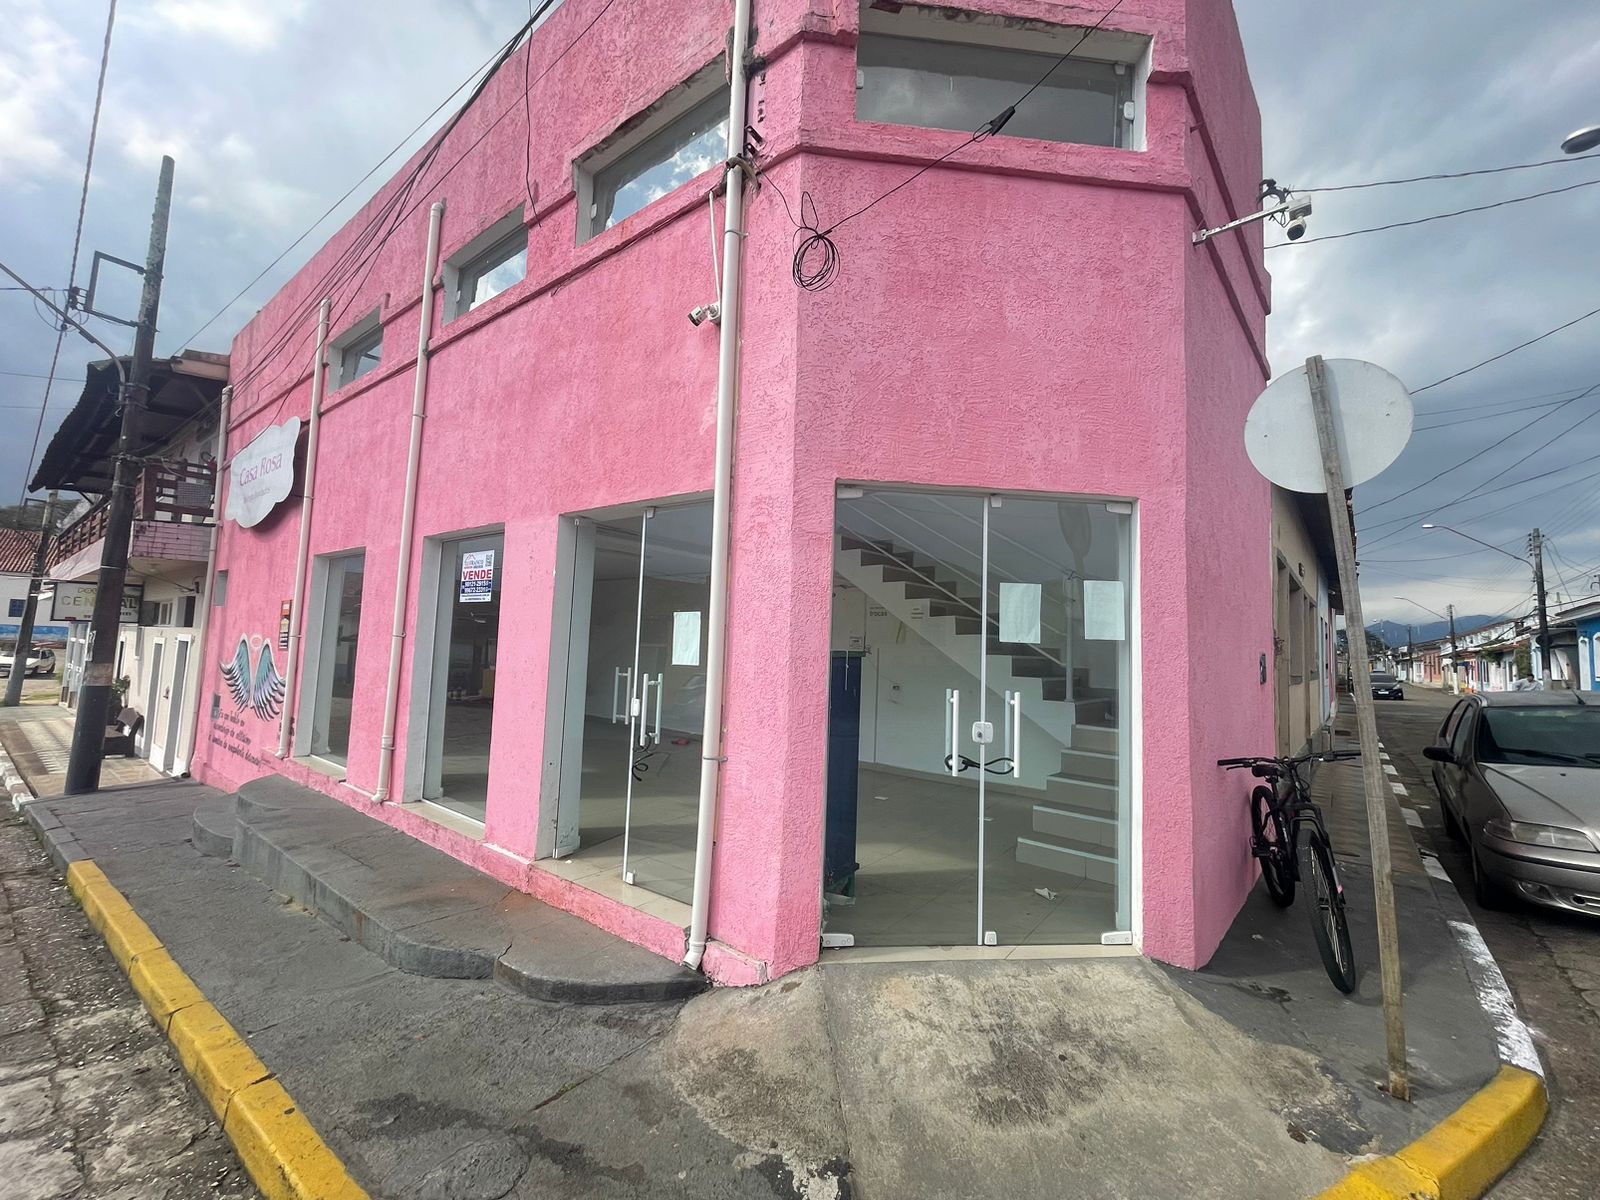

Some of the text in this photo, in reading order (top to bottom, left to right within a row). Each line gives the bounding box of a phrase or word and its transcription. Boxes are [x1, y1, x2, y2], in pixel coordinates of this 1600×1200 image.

[240, 453, 283, 487] Casa Rosa
[462, 569, 492, 580] VENDE
